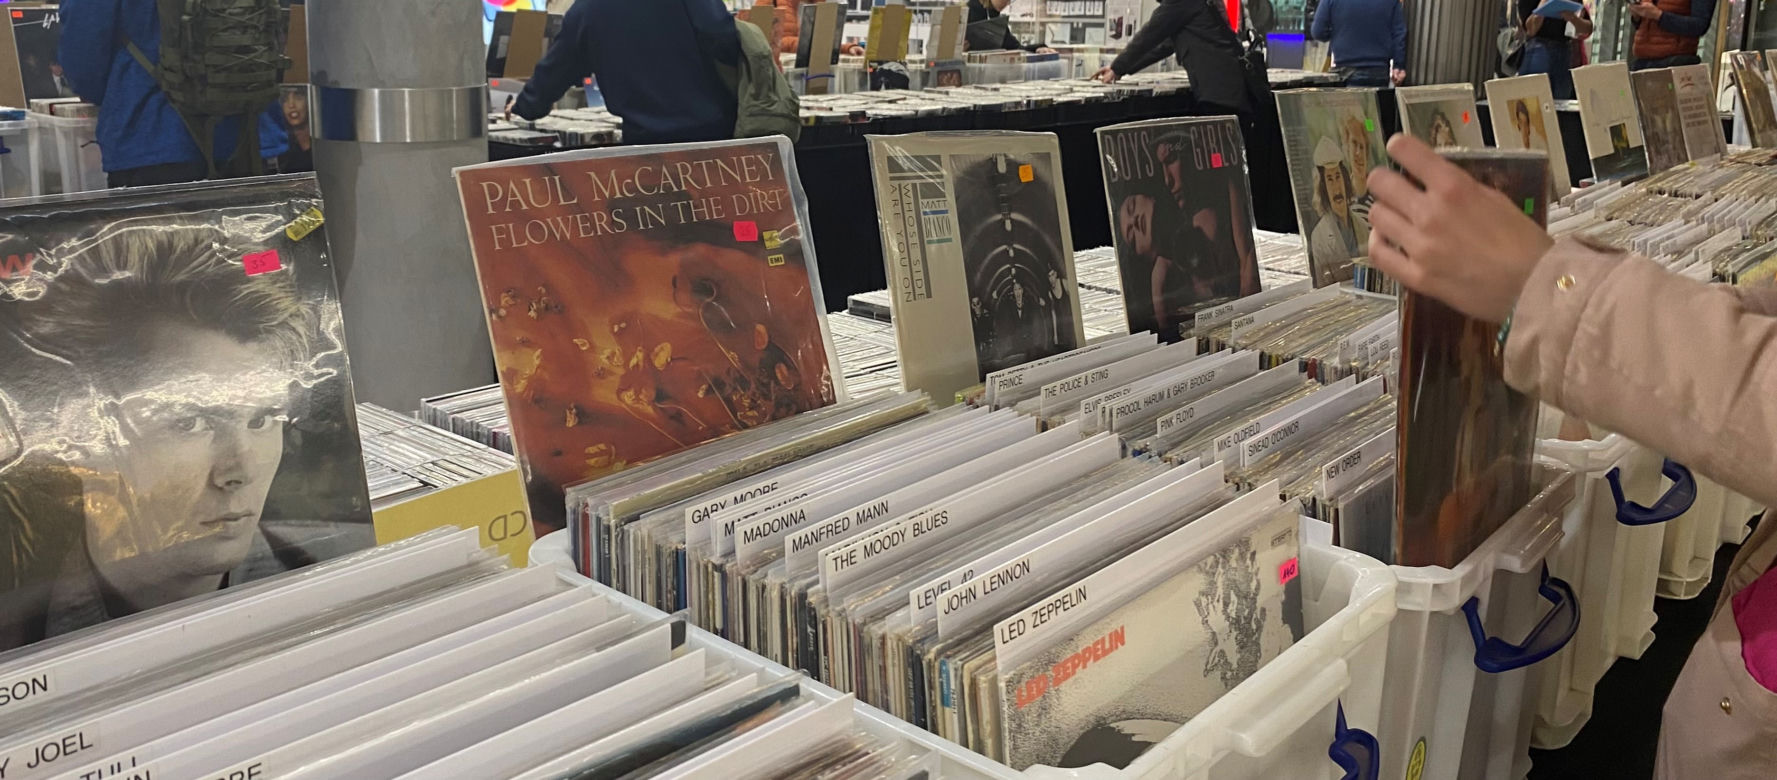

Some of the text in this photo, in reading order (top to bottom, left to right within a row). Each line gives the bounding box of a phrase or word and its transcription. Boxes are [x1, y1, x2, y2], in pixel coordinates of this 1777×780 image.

[1104, 130, 1154, 183] BOYS
[1190, 123, 1238, 170] GIRLS
[480, 153, 775, 215] PAUL McCARTNEY
[489, 188, 785, 251] FLOWERS IN THE DIRT
[921, 200, 948, 209] MATT
[889, 184, 913, 303] ARE YOU ON
[903, 184, 925, 301] WHOSE SIDE
[923, 215, 952, 239] BIANCO
[769, 256, 783, 265] EMI
[1197, 305, 1234, 323] FRANK SINATRA
[1234, 316, 1254, 330] SANTANA
[999, 374, 1023, 391] PRINCE
[1044, 385, 1057, 398] THE
[1060, 378, 1082, 393] POLICE
[1091, 369, 1109, 383] STING
[1116, 400, 1142, 419] PROCOL
[1143, 390, 1165, 411] HARUM
[1172, 380, 1188, 397] GARY
[1190, 370, 1215, 389] BROOKER
[1160, 407, 1194, 431] PINK FLOYD
[1217, 422, 1261, 453] MIKE OLDFIELD
[1248, 421, 1300, 457] SINEAD O'CONNOR
[1326, 451, 1362, 482] NEW ORDER
[488, 510, 527, 542] CD
[691, 500, 727, 524] GARY
[743, 509, 807, 544] MADONNA
[792, 517, 851, 554] MANFRED
[856, 500, 889, 526] MANN
[832, 550, 857, 573] THE
[863, 527, 907, 560] MOODY
[912, 510, 949, 538] BLUES
[917, 569, 975, 610] LEVEL 42
[943, 558, 1031, 616] JOHN LENNON
[1000, 585, 1088, 645] LED ZEPPELIN
[1016, 673, 1048, 709] LED
[1050, 625, 1126, 688] ZEPPELIN
[26, 731, 94, 769] JOEL
